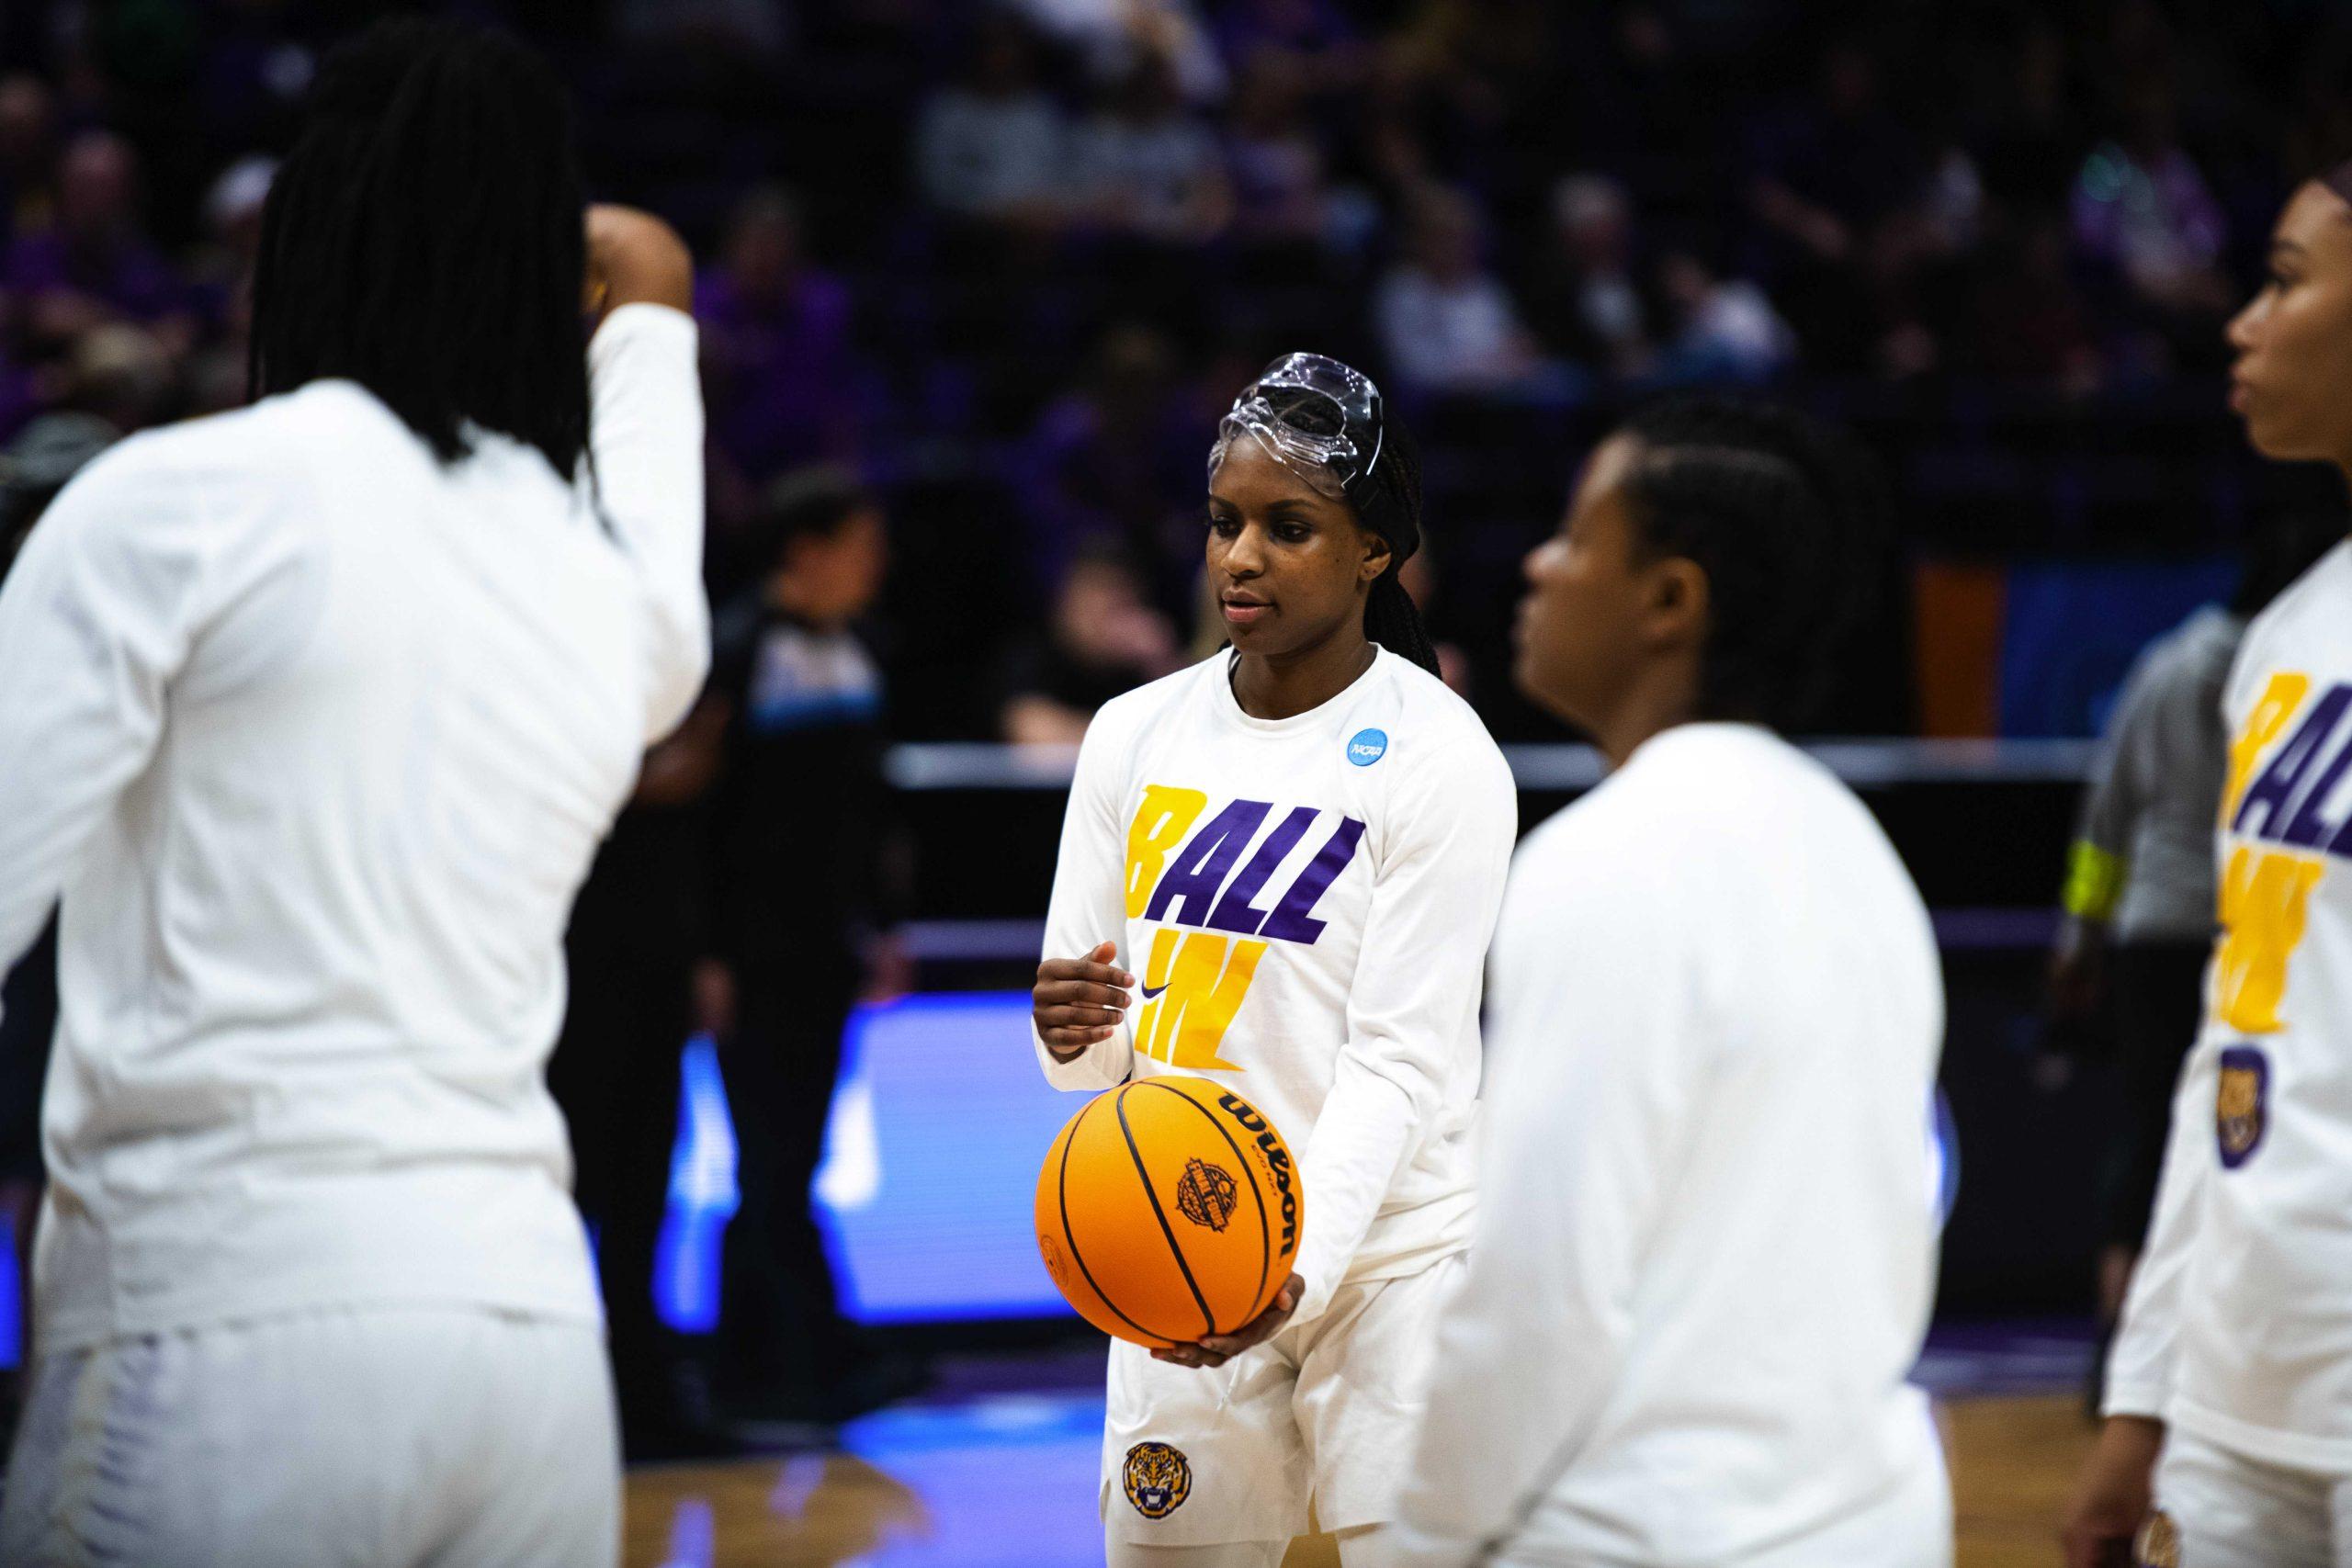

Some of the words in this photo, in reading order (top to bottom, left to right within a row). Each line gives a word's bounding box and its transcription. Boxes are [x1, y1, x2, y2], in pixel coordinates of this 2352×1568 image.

[2218, 673, 2352, 860] BAL
[1125, 784, 1367, 945] BALL
[1134, 928, 1270, 1072] IN
[1188, 1161, 1212, 1197] FINAL
[1204, 1194, 1226, 1227] FOUR
[1218, 1090, 1296, 1260] Wilson
